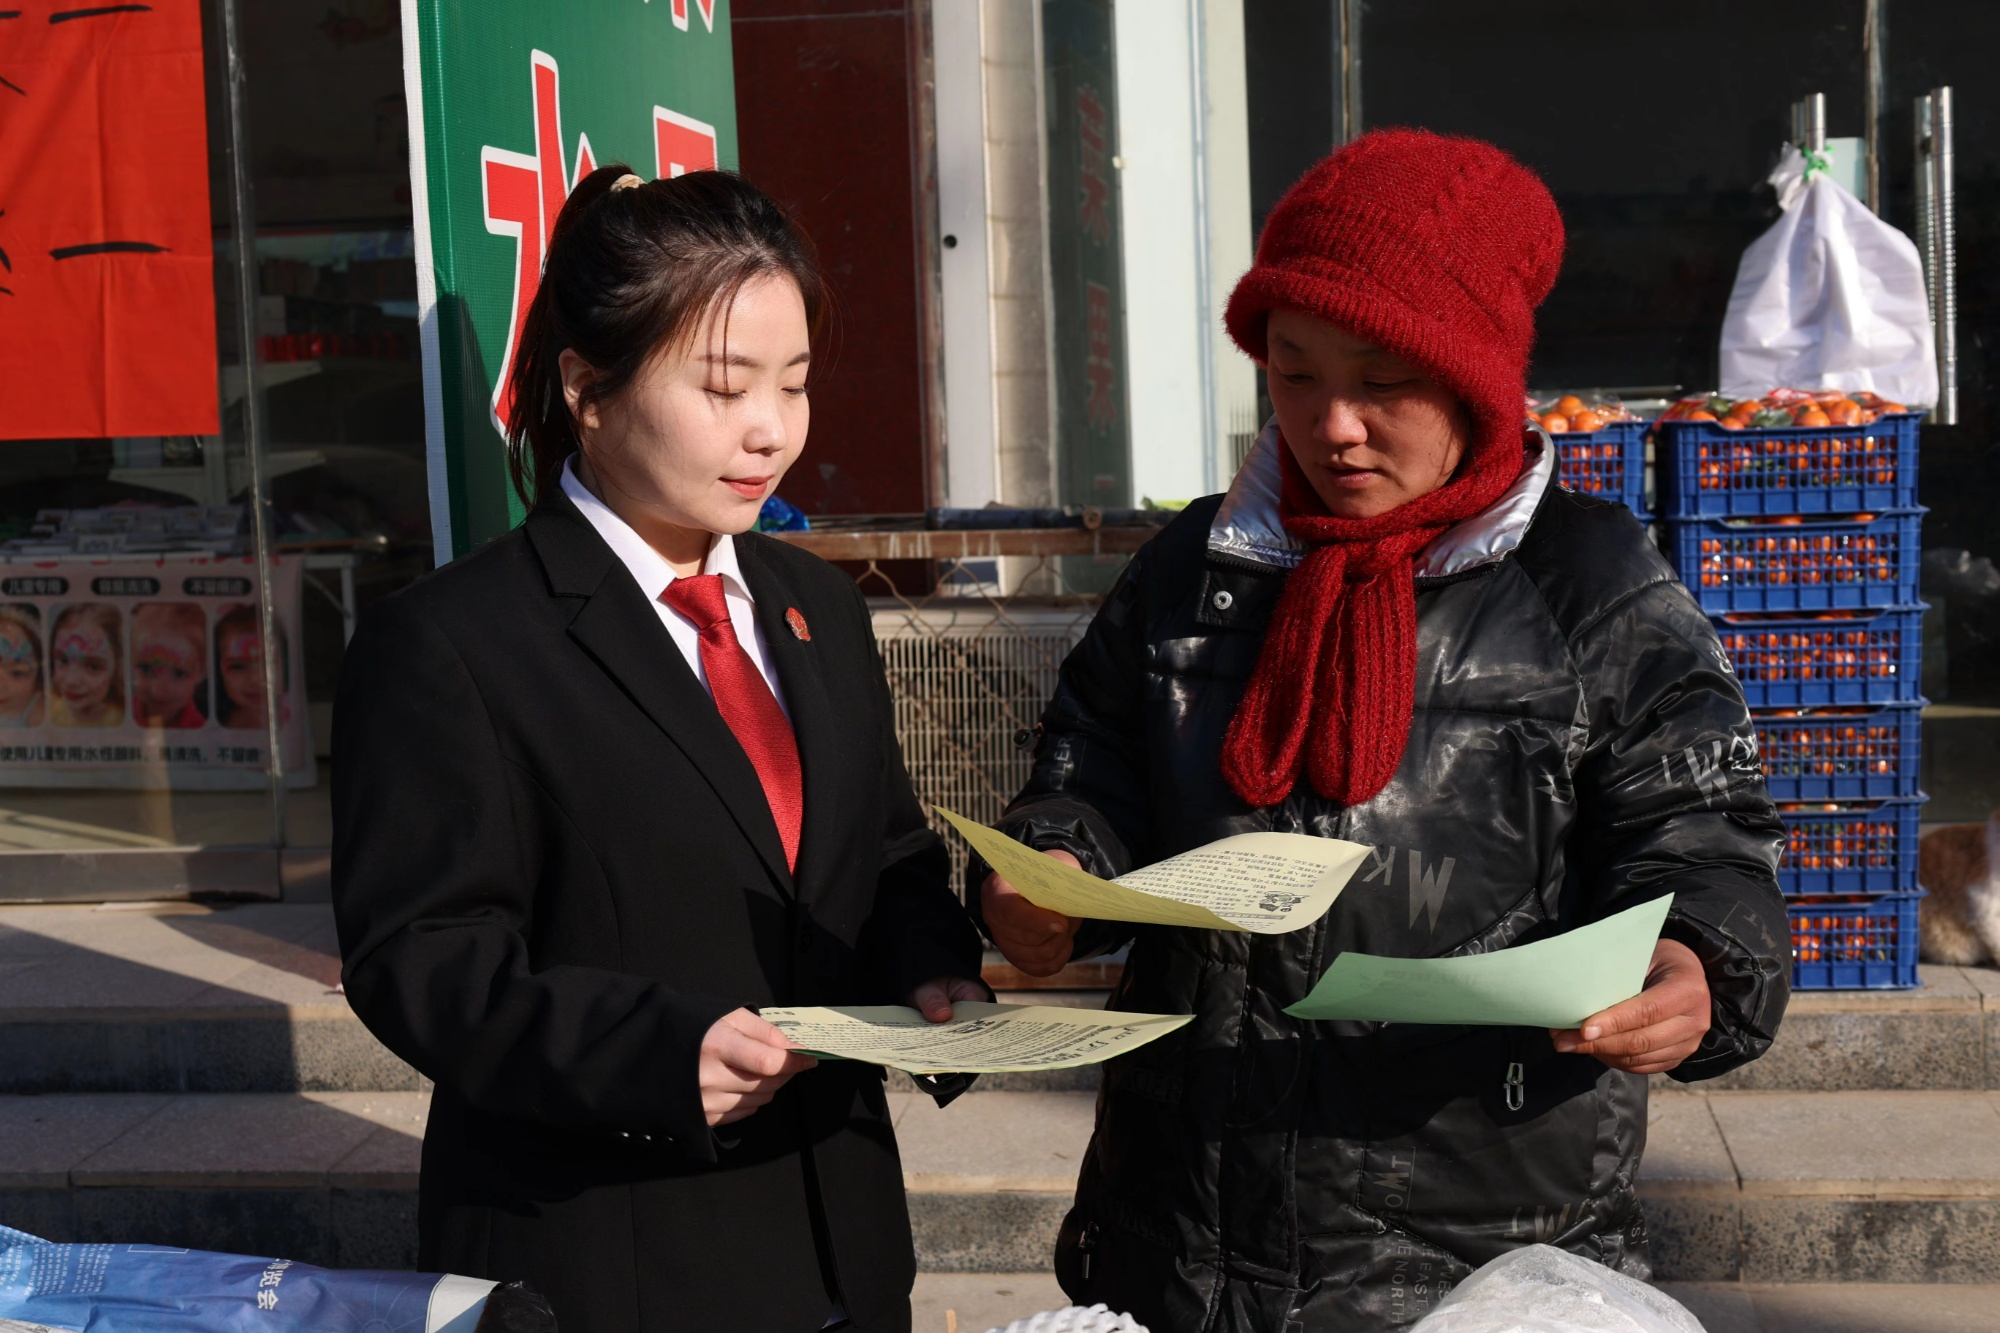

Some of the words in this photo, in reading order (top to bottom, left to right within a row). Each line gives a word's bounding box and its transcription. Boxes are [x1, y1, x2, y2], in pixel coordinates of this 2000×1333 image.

[1391, 1260, 1409, 1324] NORTH
[1414, 1262, 1432, 1308] EAST
[1437, 1265, 1455, 1301] WES
